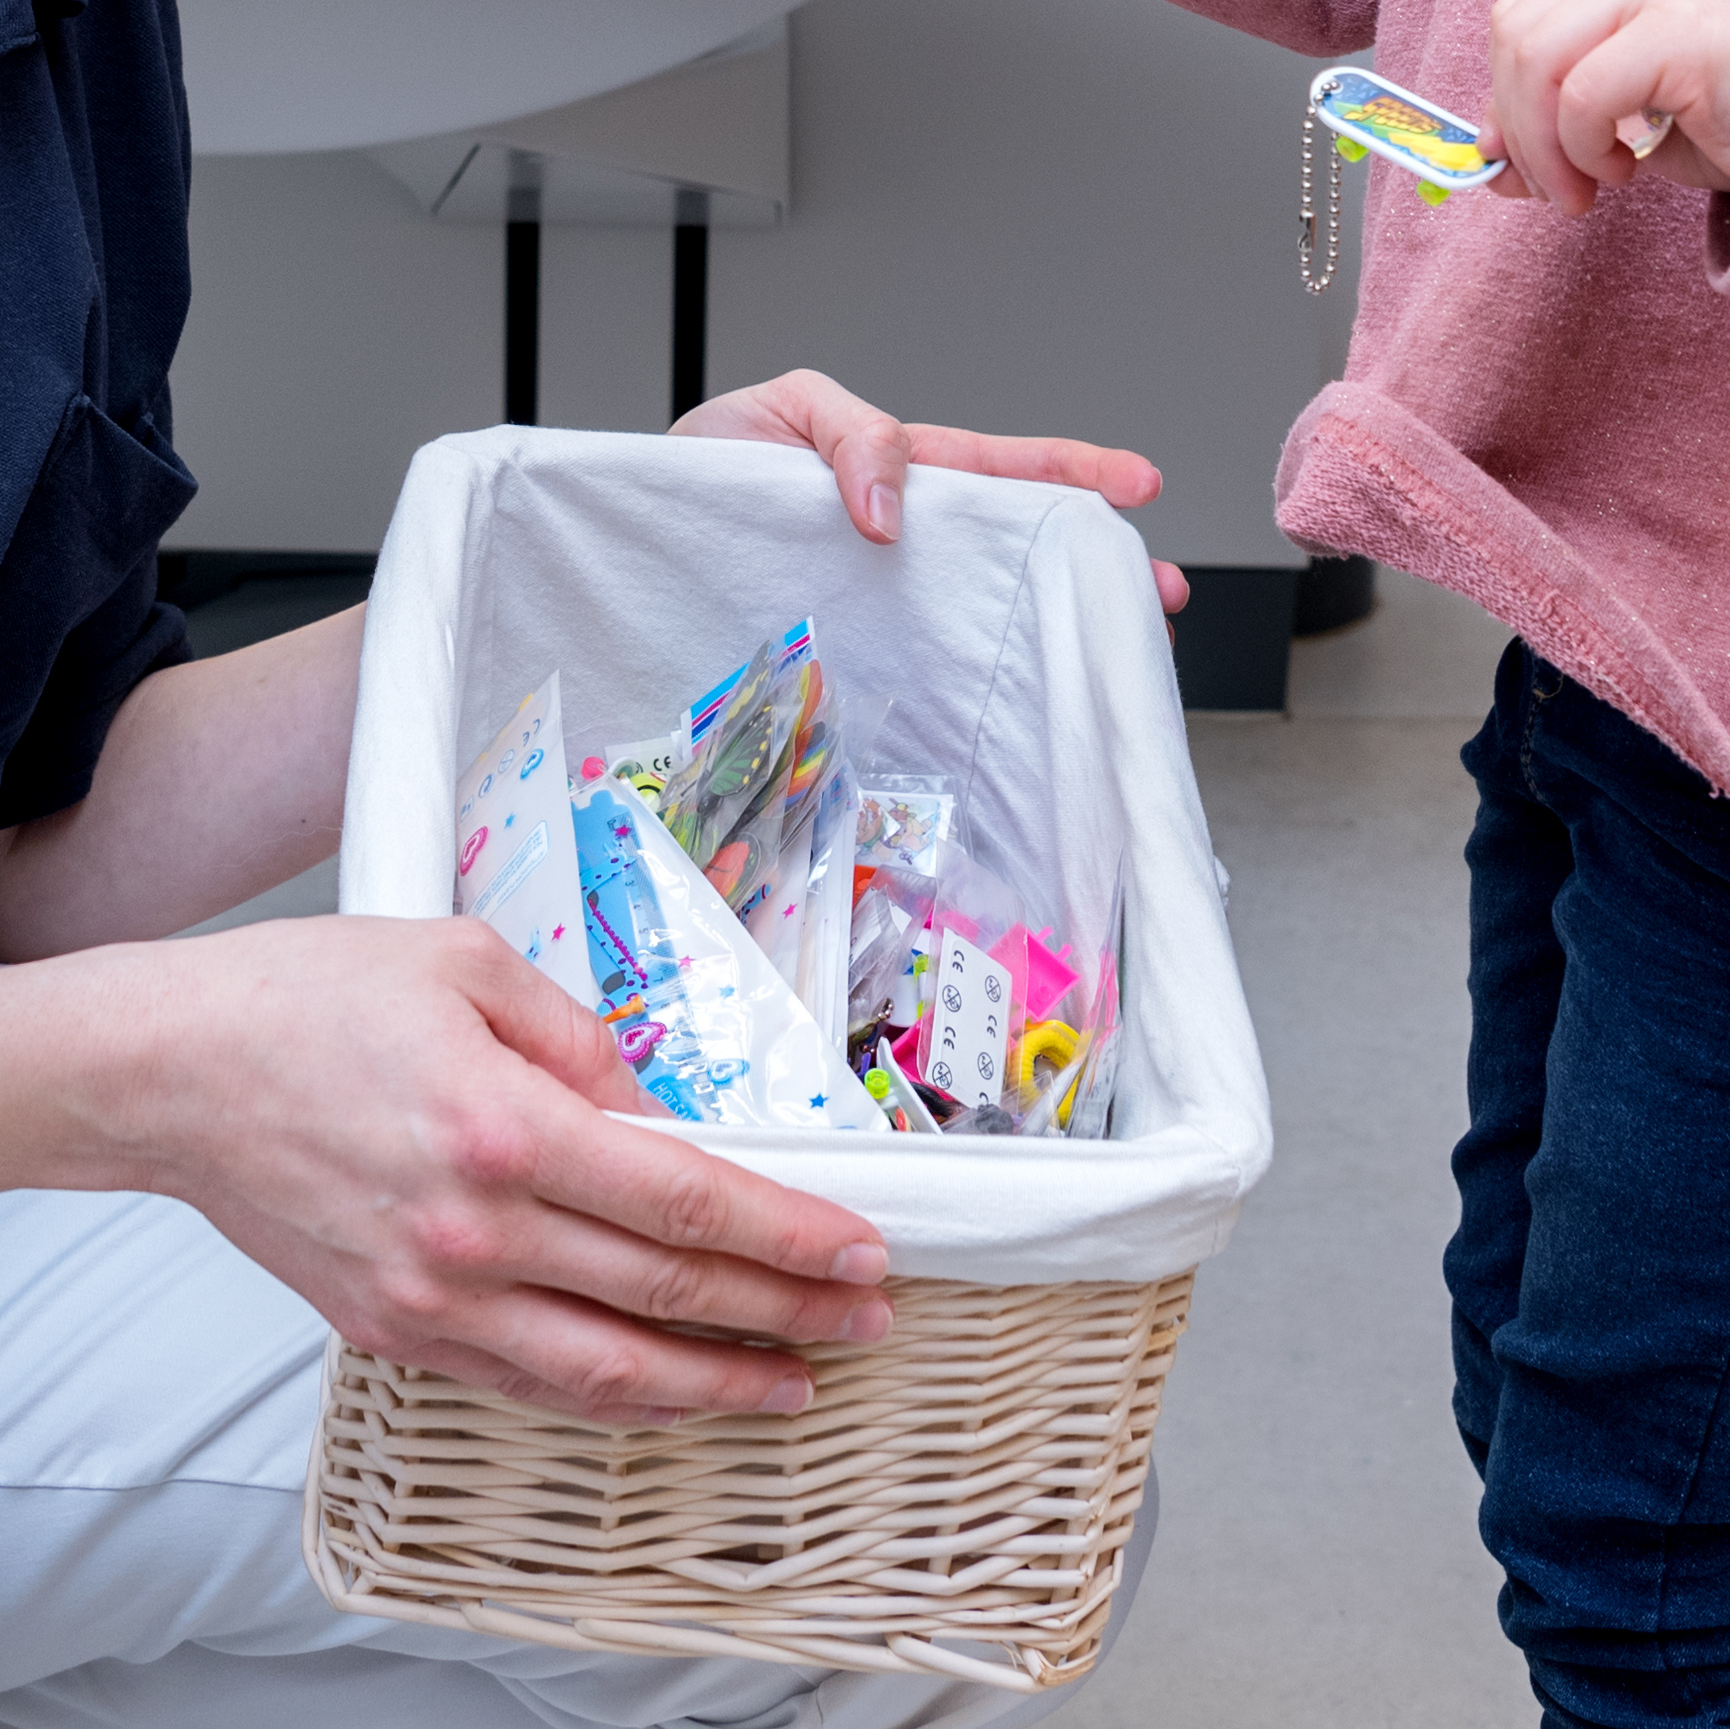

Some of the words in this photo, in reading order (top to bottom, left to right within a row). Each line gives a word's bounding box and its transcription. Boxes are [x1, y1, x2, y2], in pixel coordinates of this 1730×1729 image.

[653, 755, 671, 772] CE
[952, 949, 965, 973] CE
[943, 1025, 957, 1050] CE
[986, 1014, 998, 1039] CE
[652, 1081, 679, 1109] HOT
